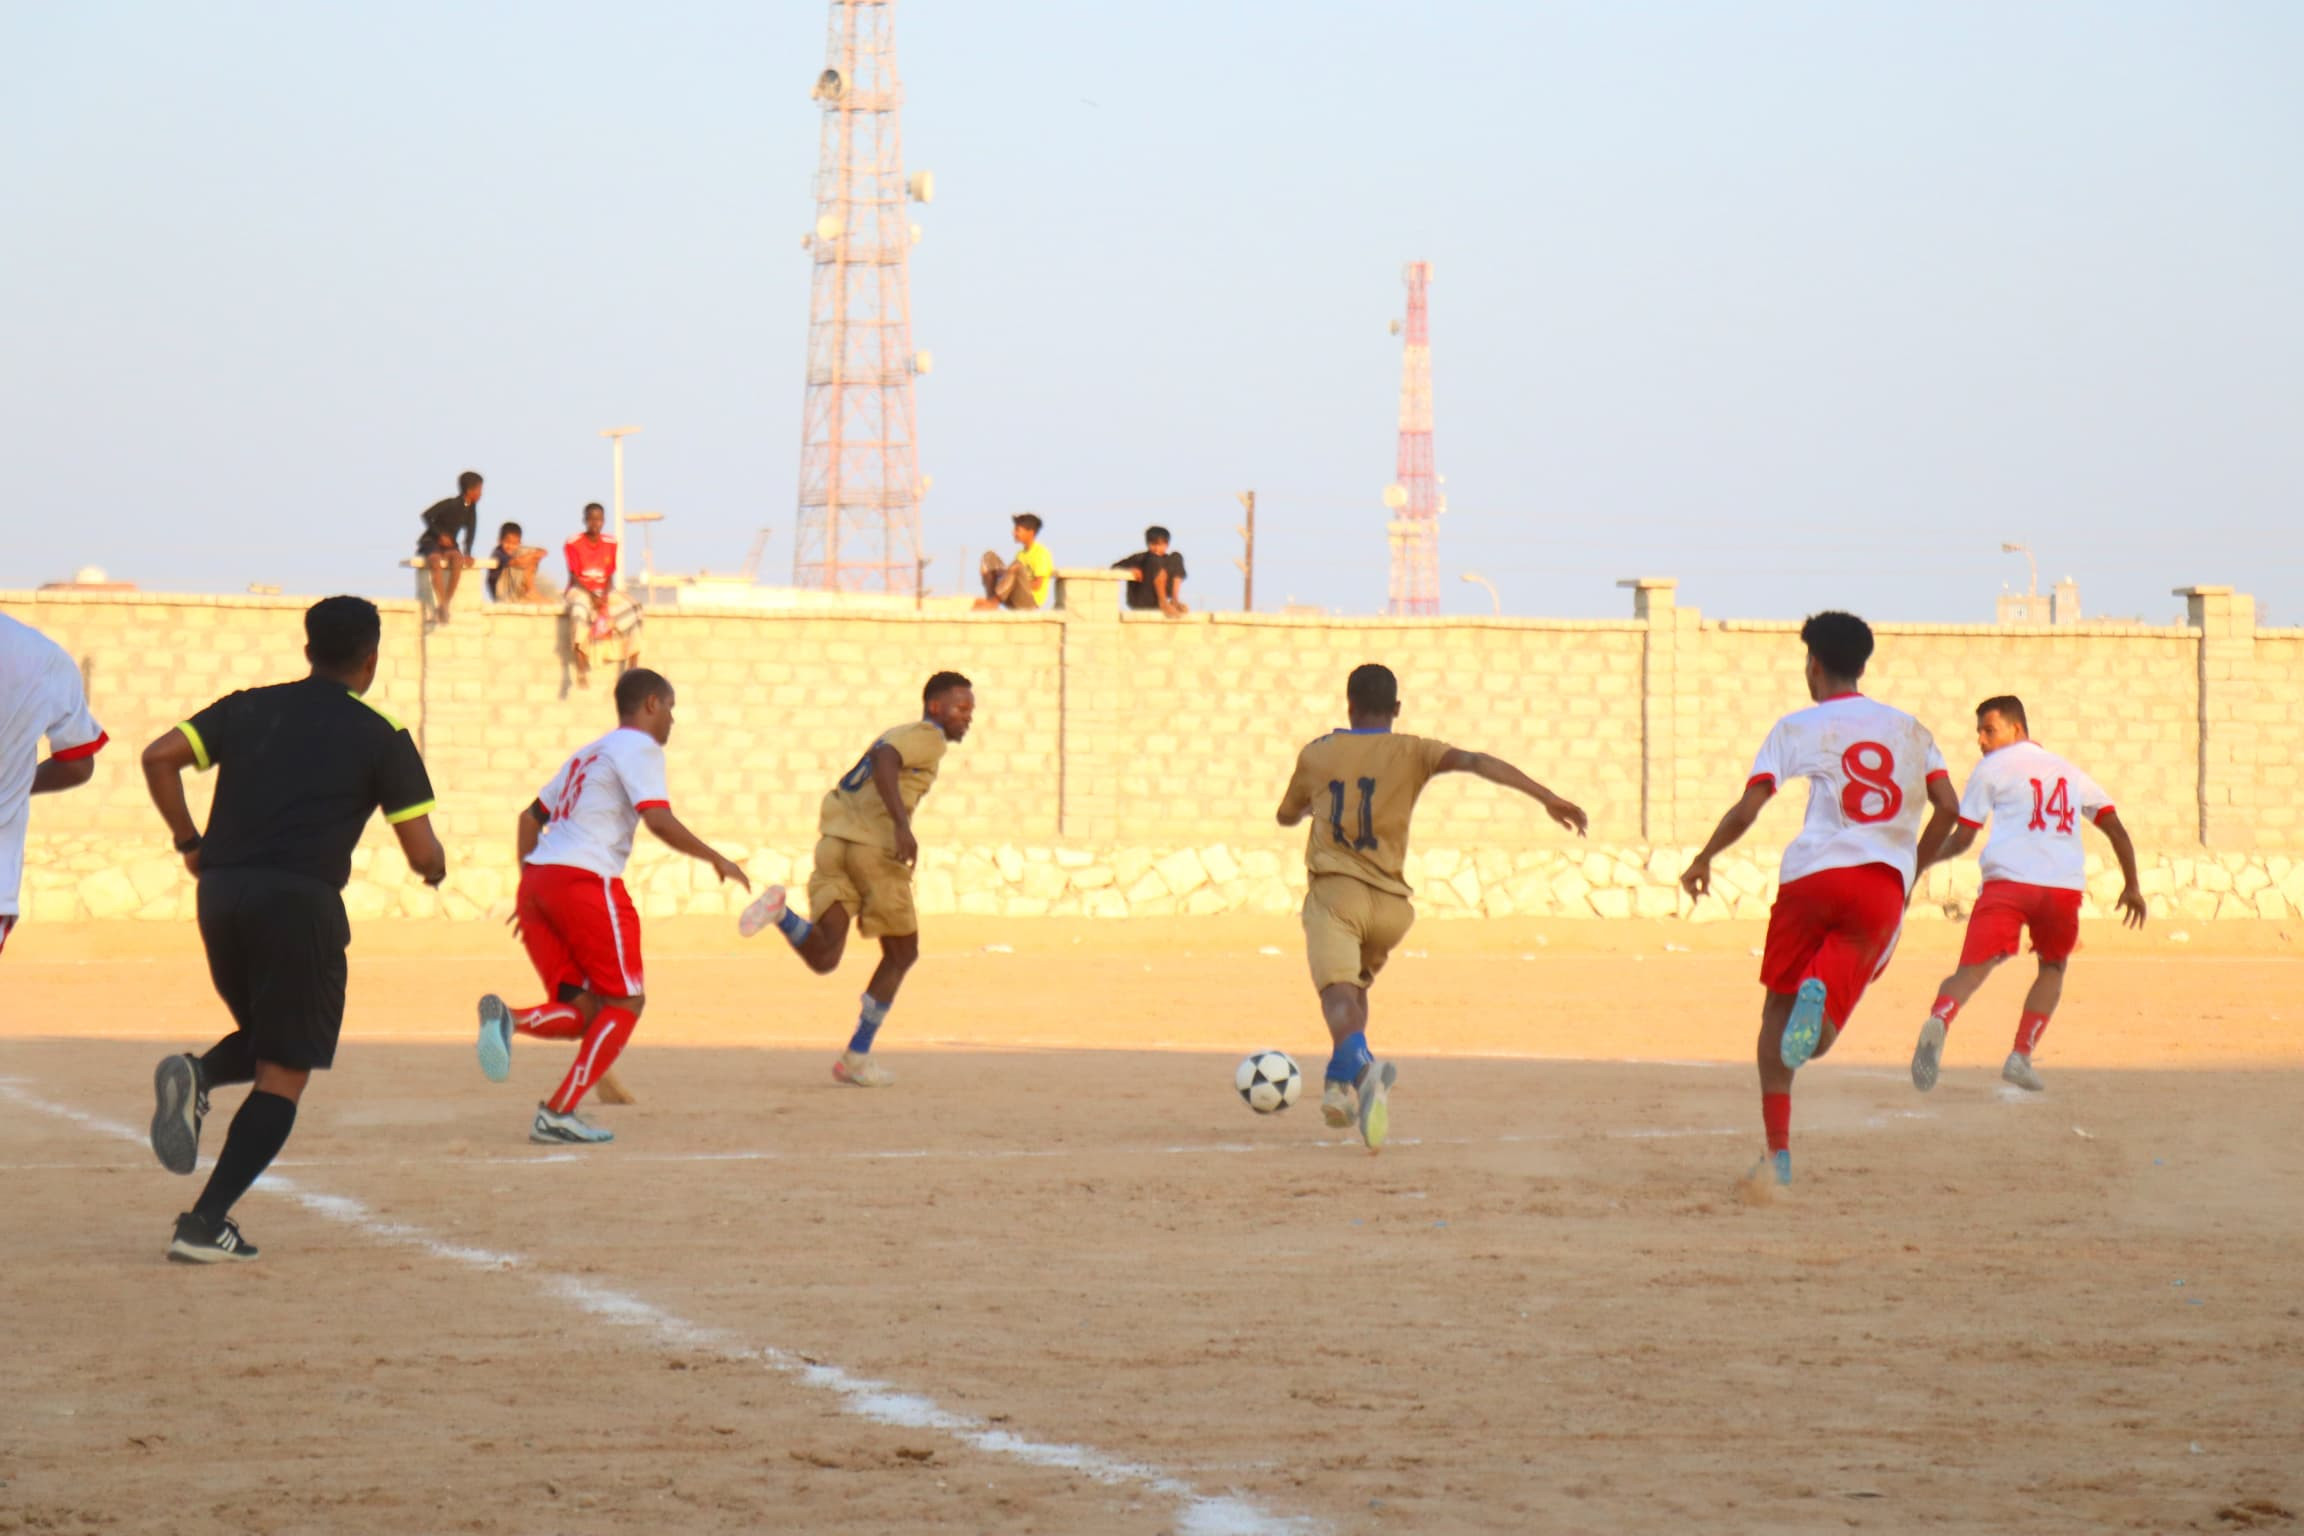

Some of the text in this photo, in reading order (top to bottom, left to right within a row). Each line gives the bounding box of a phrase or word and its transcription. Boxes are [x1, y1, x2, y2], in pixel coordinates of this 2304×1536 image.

[1328, 776, 1379, 852] 11
[1841, 741, 1903, 824] 8
[2027, 777, 2075, 836] 14
